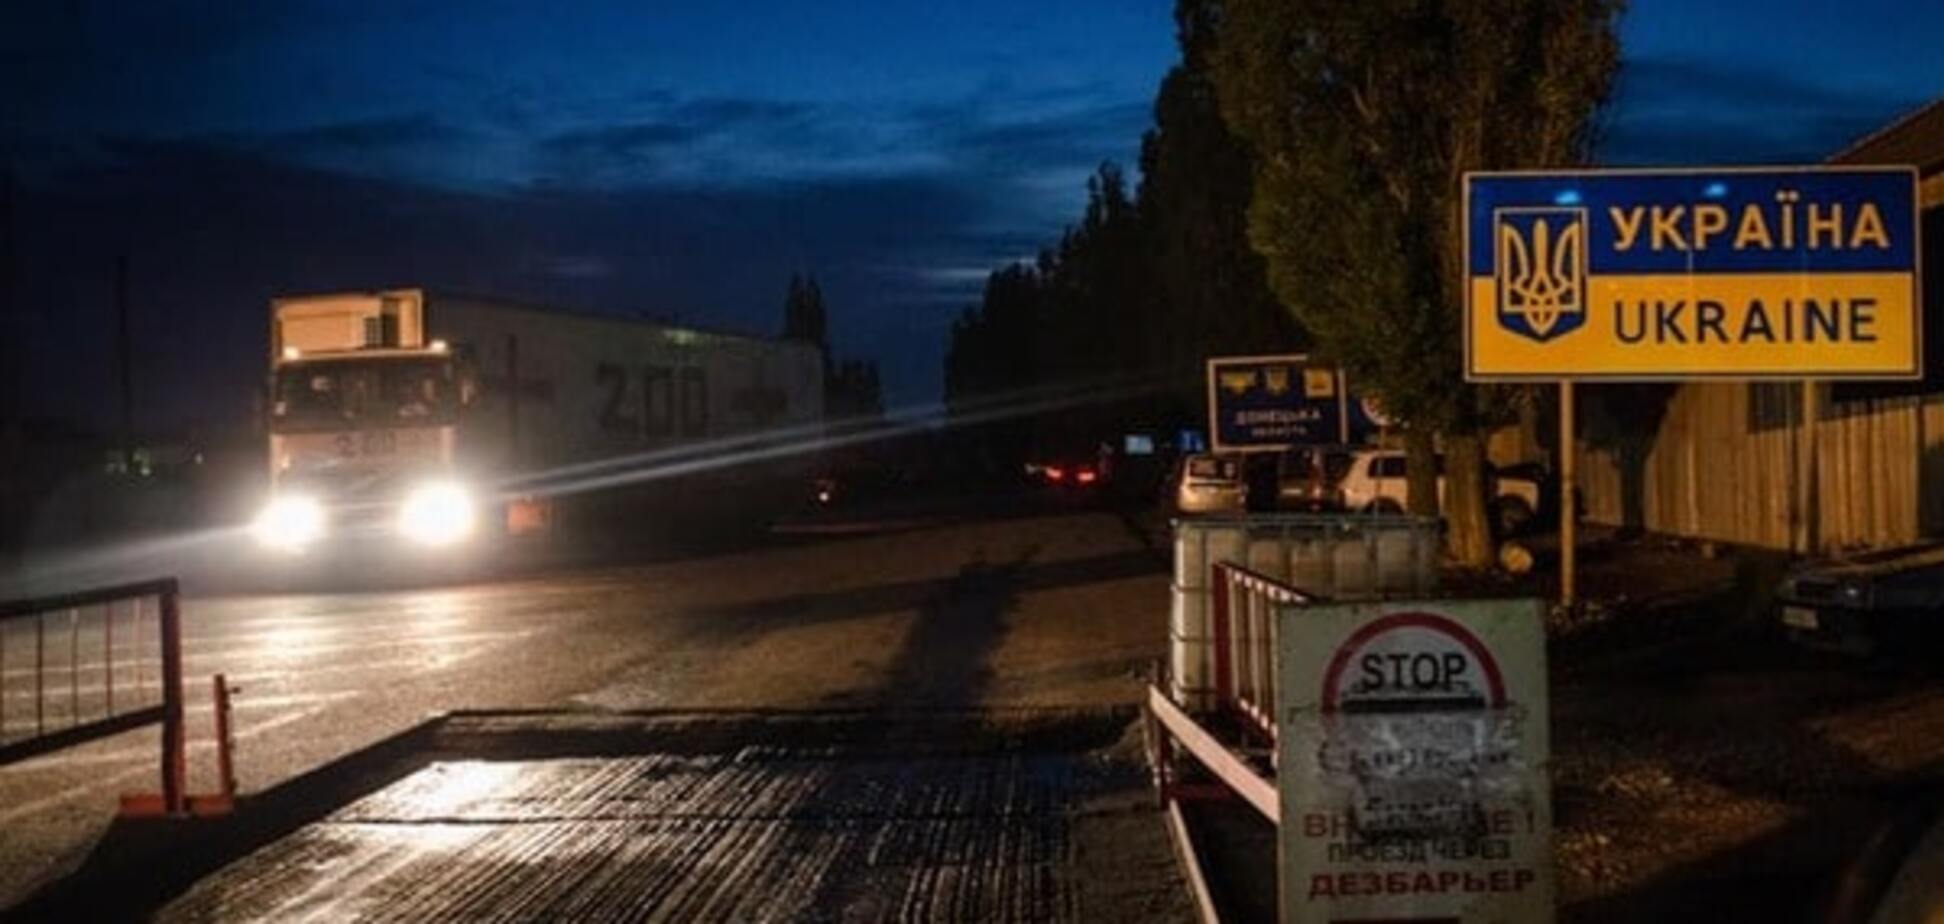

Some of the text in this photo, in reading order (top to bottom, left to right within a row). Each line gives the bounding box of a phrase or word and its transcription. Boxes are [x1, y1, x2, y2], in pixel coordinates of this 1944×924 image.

[1608, 190, 1890, 250] УКРАЇНА
[1613, 298, 1878, 344] UKRAINE
[1361, 652, 1468, 691] STOP
[1308, 868, 1536, 900] ДЕЗБАРЬЕР
